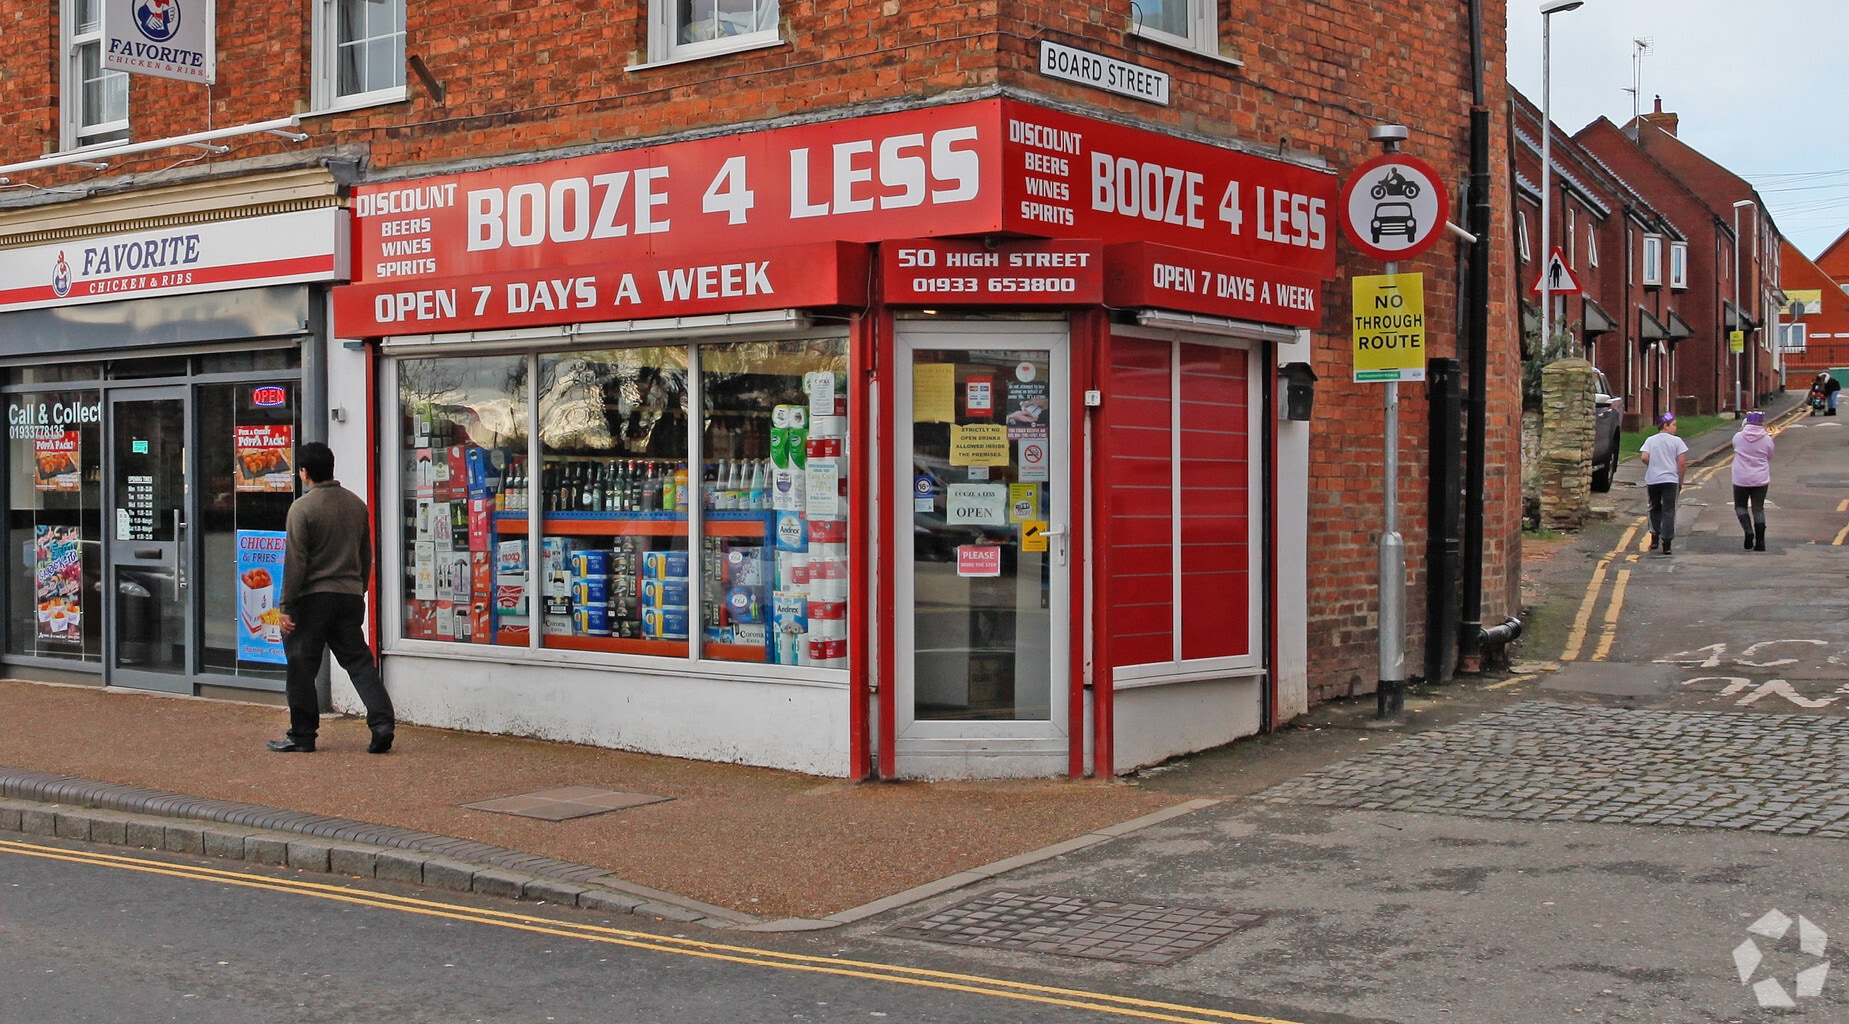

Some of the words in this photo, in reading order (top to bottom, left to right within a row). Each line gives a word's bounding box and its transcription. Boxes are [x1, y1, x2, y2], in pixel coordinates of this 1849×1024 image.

[108, 38, 203, 67] FAVORITE
[108, 55, 160, 69] CHICKEN
[177, 67, 204, 76] RIBS
[1047, 48, 1102, 81] BOARD
[1108, 63, 1162, 97] STREET
[1009, 119, 1082, 155] DISCOUNT
[1025, 151, 1069, 177] BEERS
[467, 165, 670, 252] BOOZE
[702, 155, 754, 225] 4
[789, 126, 979, 219] LESS
[1025, 176, 1070, 201] WINES
[356, 183, 457, 218] DISCOUNT
[1091, 151, 1205, 229] BOOZE
[1218, 181, 1242, 235] 4
[1256, 186, 1326, 250] LESS
[1021, 201, 1074, 226] SPIRITS
[381, 217, 431, 237] BEERS
[82, 234, 200, 276] FAVORITE
[381, 238, 431, 257] WINES
[376, 258, 436, 277] SPIRITS
[898, 249, 935, 267] 50
[946, 252, 999, 267] HIGH
[1009, 252, 1090, 267] STREET
[89, 278, 146, 294] CHICKEN
[150, 277, 158, 288] &
[162, 272, 193, 287] RIBS
[375, 288, 457, 323] OPEN
[471, 286, 492, 316] 7
[507, 276, 597, 314] DAYS
[613, 273, 642, 305] A
[657, 260, 774, 302] WEEK
[912, 278, 978, 292] 01933
[988, 278, 1075, 292] 653800
[1153, 263, 1195, 293] OPEN
[1201, 271, 1211, 295] 7
[1216, 275, 1254, 302] DAYS
[1260, 281, 1271, 305] A
[1276, 283, 1314, 311] WEEK
[1375, 294, 1403, 309] NO
[1355, 314, 1422, 330] THROUGH
[1359, 334, 1420, 350] ROUTE
[253, 389, 286, 403] OPEN
[8, 403, 34, 425] Call
[38, 403, 49, 424] &
[53, 401, 102, 424] Collect
[9, 424, 65, 439] 01933778135
[956, 506, 993, 518] OPEN
[779, 526, 800, 534] Andrex
[242, 553, 251, 562] &
[252, 552, 276, 563] FRIES
[963, 551, 995, 560] PLEASE
[777, 605, 799, 614] Andrex
[740, 630, 764, 639] Corona
